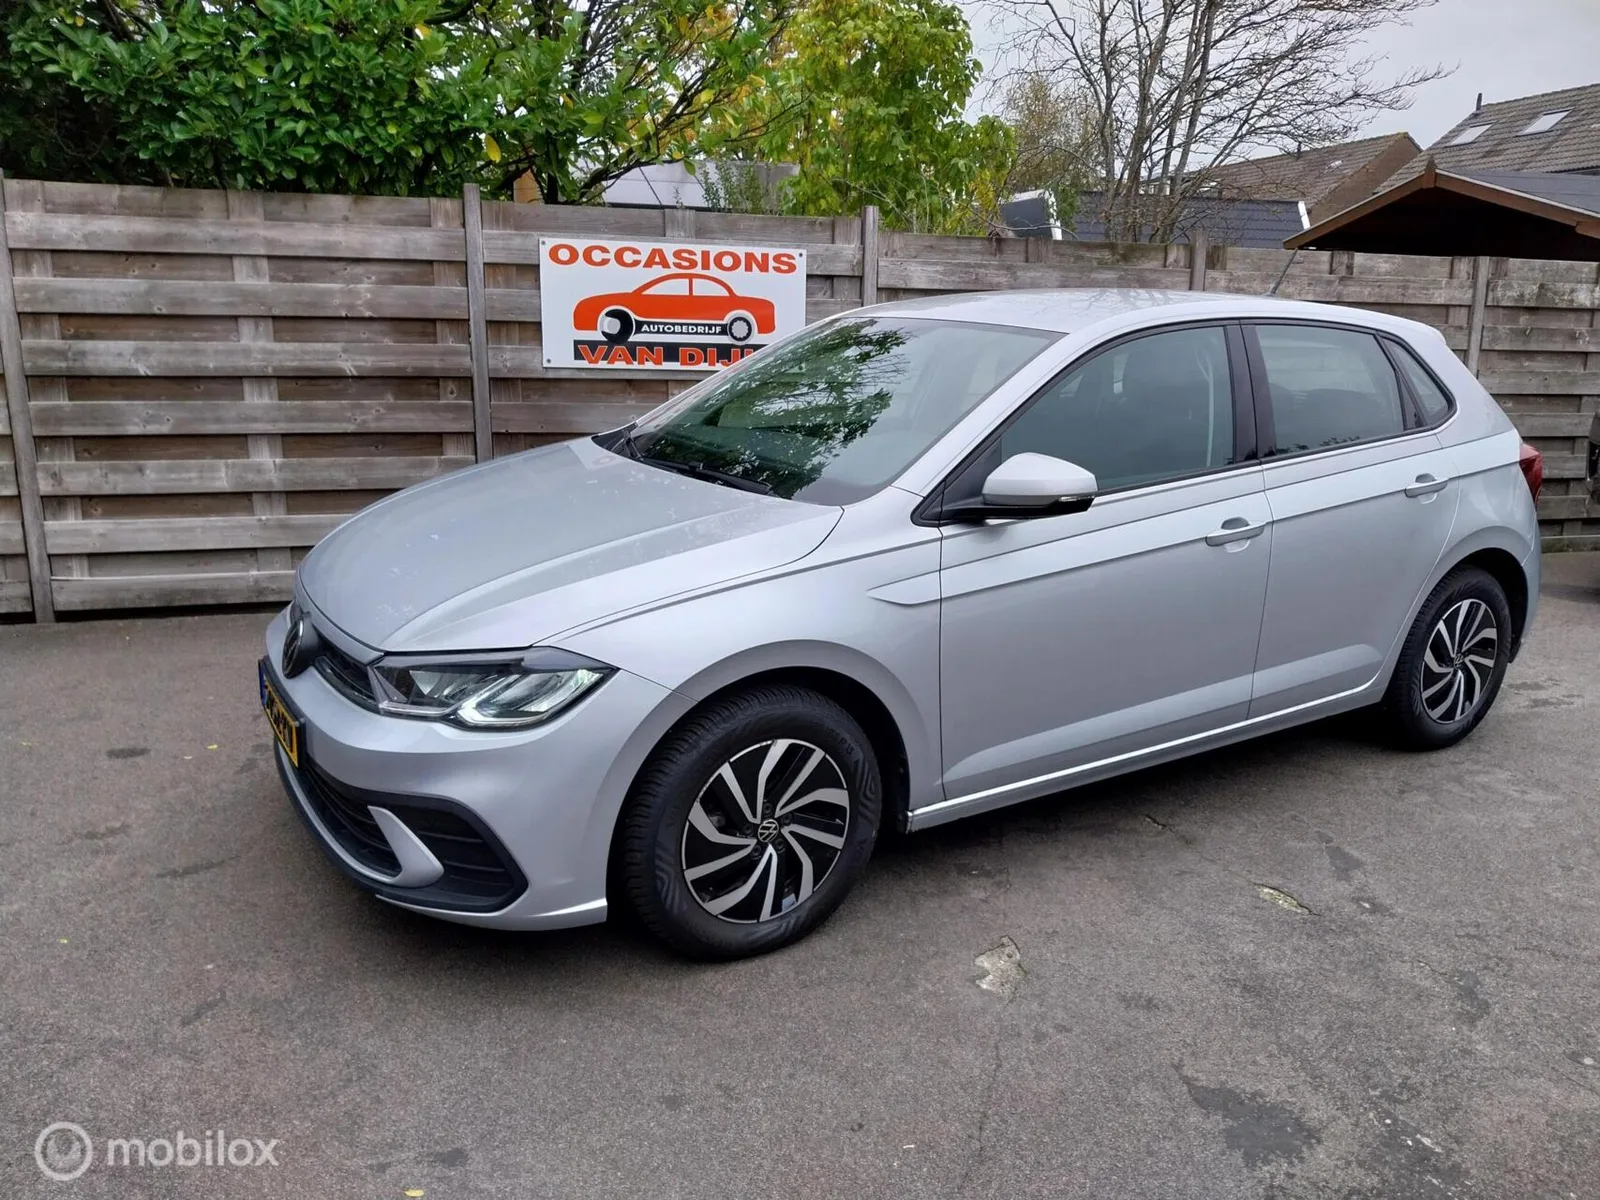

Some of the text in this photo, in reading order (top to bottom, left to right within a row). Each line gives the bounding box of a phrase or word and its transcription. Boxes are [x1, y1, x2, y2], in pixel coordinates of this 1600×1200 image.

[549, 243, 798, 274] OCCASIONS
[640, 323, 723, 335] AUTOBEDRIJF
[577, 344, 755, 368] VAN DIJ
